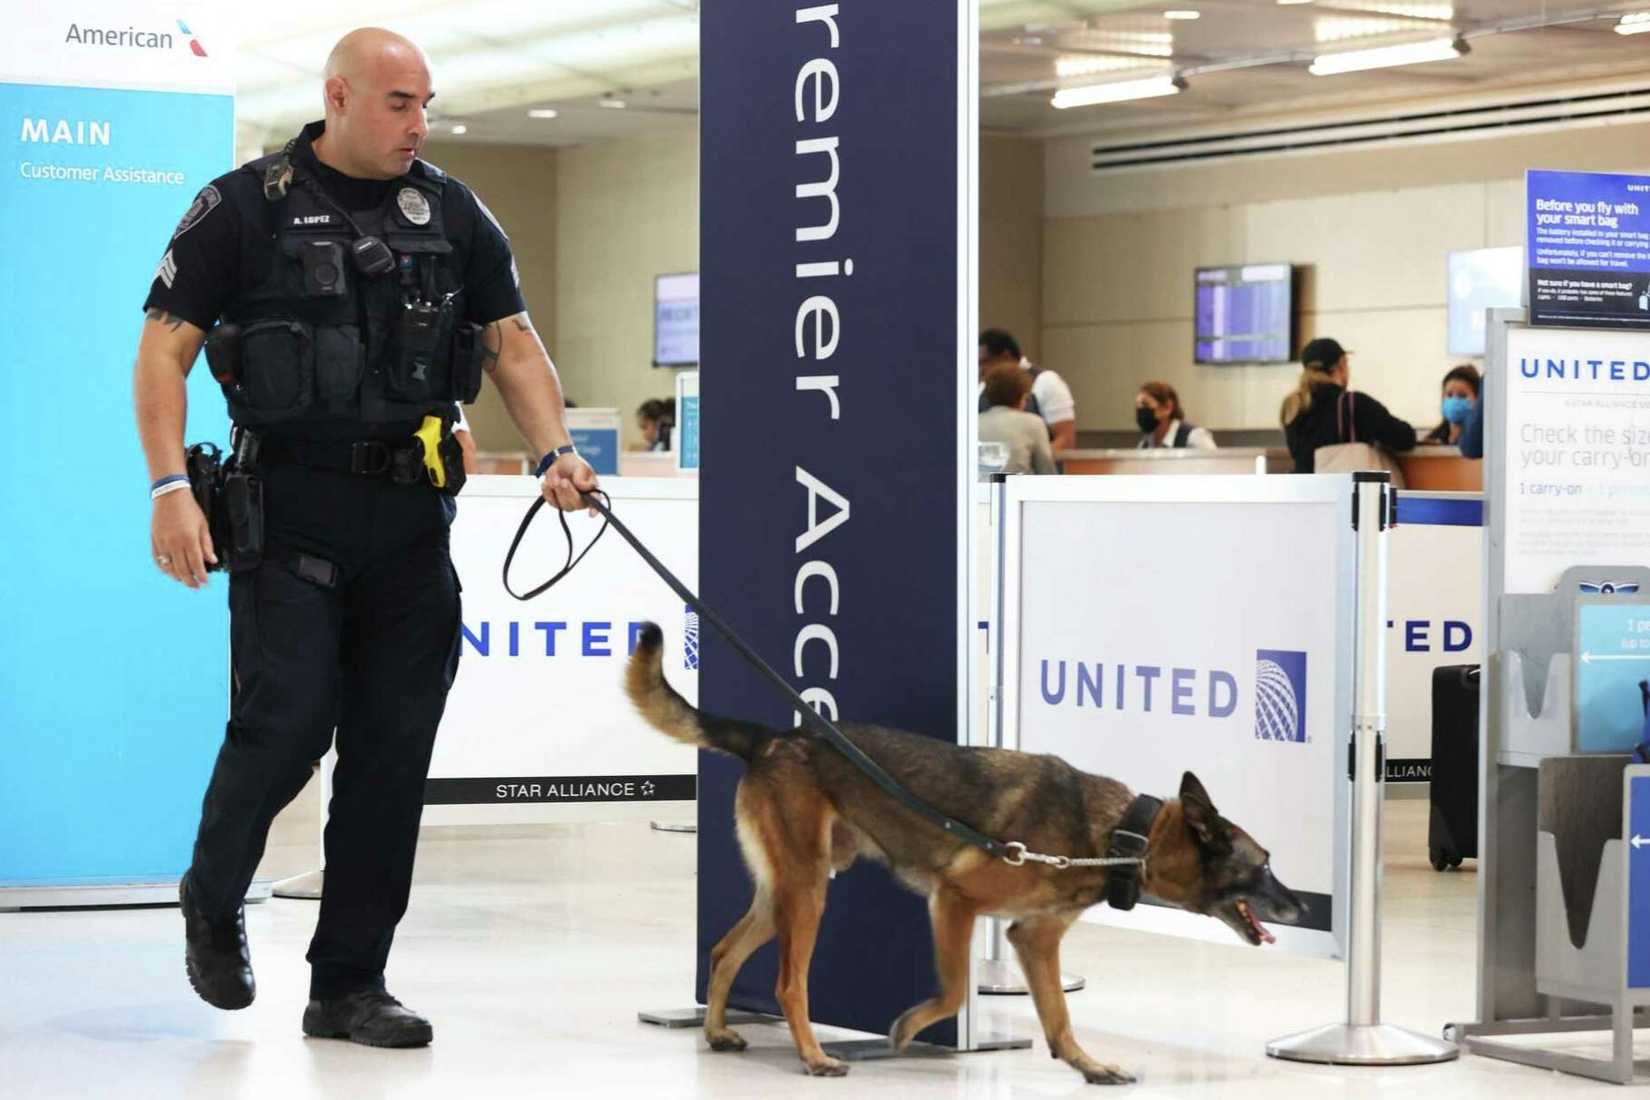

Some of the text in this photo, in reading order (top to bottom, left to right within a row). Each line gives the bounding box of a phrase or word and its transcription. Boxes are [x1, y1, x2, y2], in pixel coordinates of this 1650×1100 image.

[65, 23, 173, 49] American
[20, 117, 110, 146] MAIN
[20, 161, 185, 185] Customer Assistance
[1627, 184, 1650, 192] UNIT
[795, 3, 854, 420] remier
[1536, 199, 1639, 216] Before you fly with
[304, 215, 330, 225] LOPEZ
[1536, 214, 1618, 229] your smart bag
[1521, 358, 1650, 381] UNITED
[1521, 423, 1578, 444] Check
[1584, 425, 1616, 445] the
[1520, 449, 1565, 469] your
[1529, 484, 1583, 497] carry-on
[461, 622, 645, 656] NITE
[1387, 621, 1473, 652] ED
[1041, 659, 1238, 718] UNITED
[1381, 766, 1432, 778] LLIAN
[496, 783, 635, 798] STAR ALLIANCE
